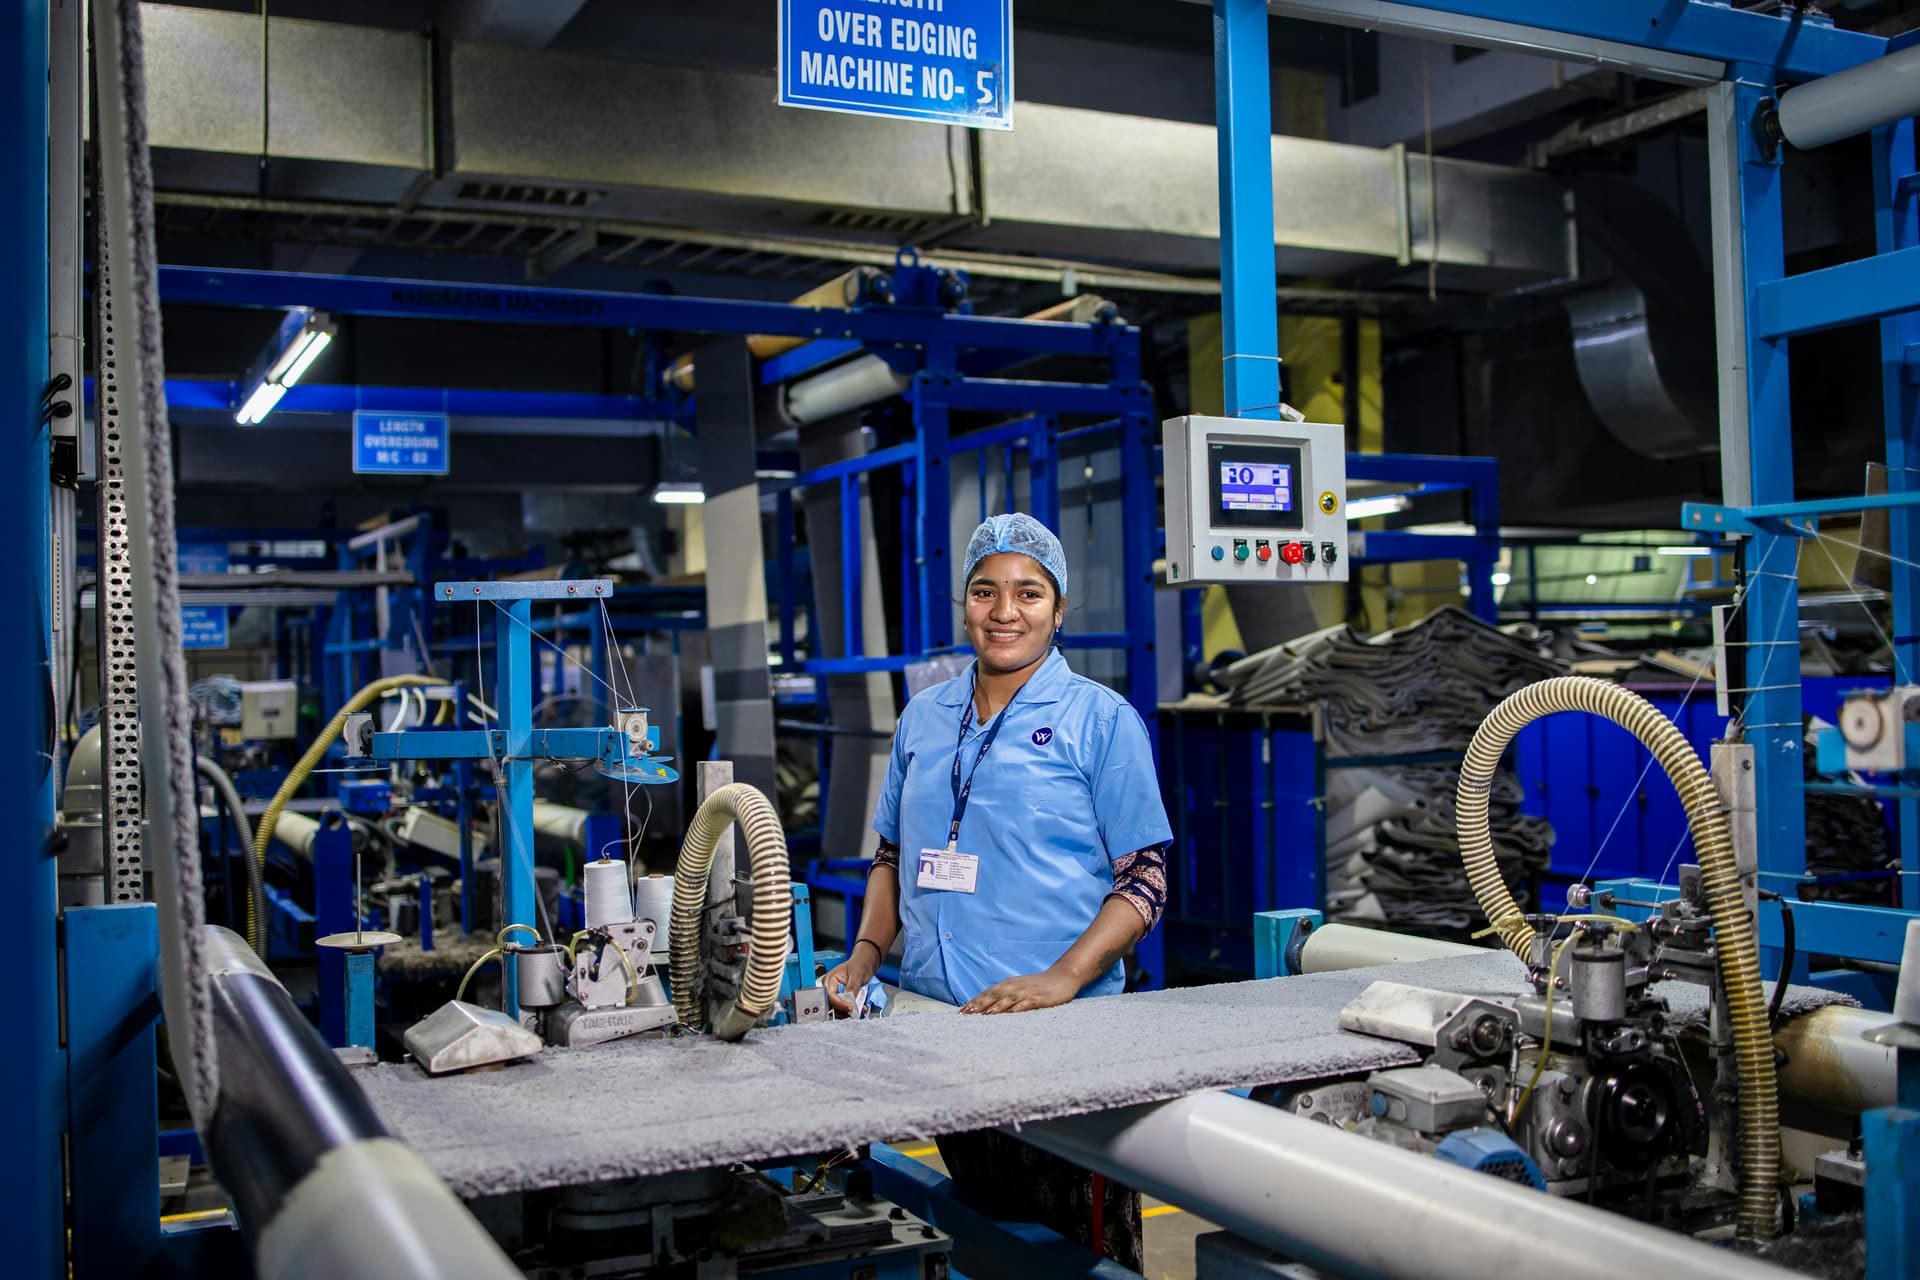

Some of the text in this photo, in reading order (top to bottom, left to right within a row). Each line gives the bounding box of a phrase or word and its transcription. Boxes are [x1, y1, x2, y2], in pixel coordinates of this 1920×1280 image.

[818, 8, 977, 60] OVER EDGING
[801, 51, 913, 96] MACHINE
[976, 71, 993, 104] 5
[379, 420, 425, 433] LENGTH
